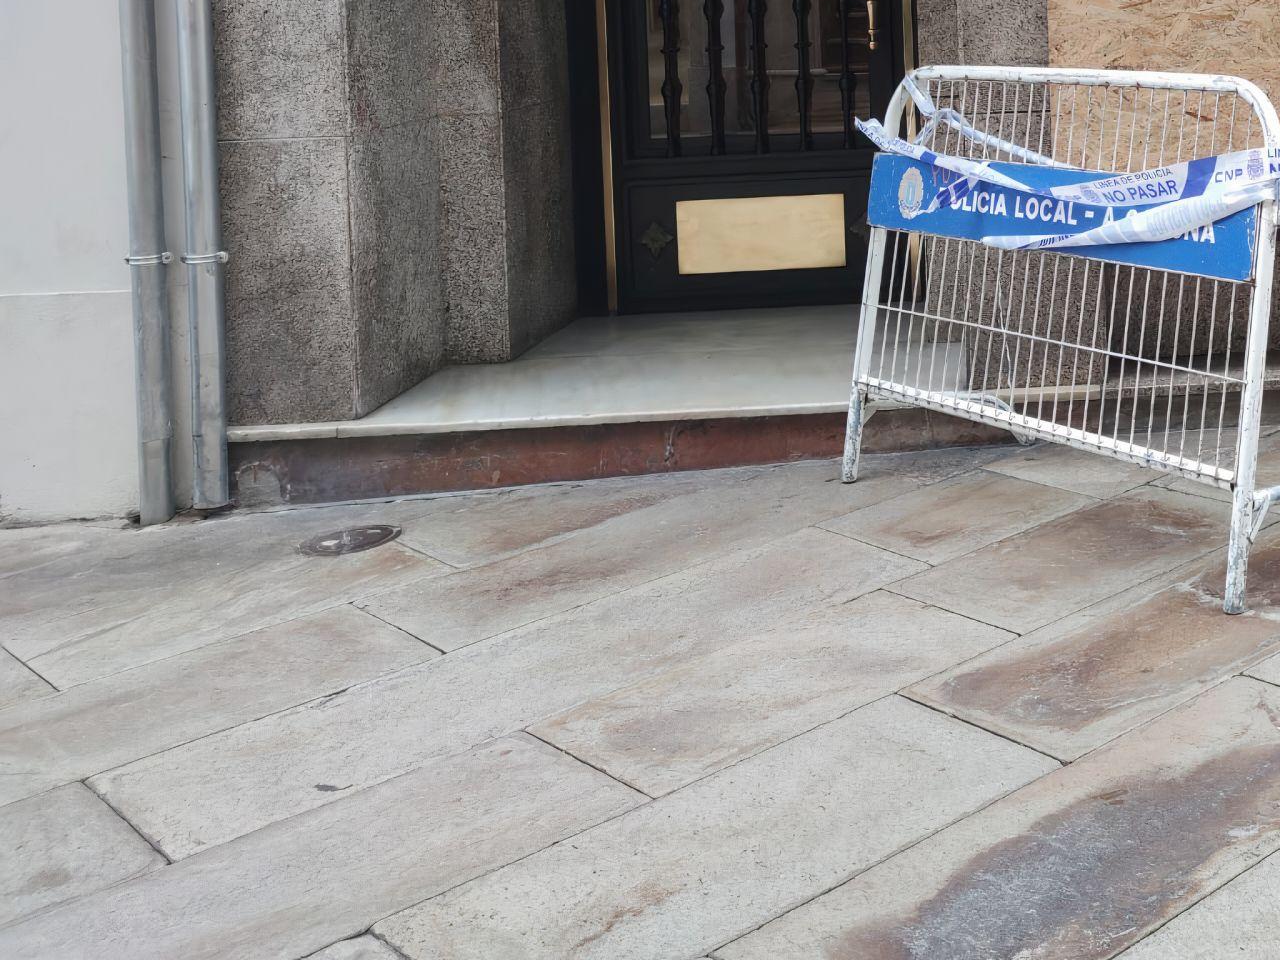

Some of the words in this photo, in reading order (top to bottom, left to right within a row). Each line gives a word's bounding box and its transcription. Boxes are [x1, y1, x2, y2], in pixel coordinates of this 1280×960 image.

[1214, 168, 1243, 184] CNP
[1102, 189, 1127, 203] NO
[1127, 180, 1179, 201] PASAR
[1014, 192, 1077, 225] LOCAL
